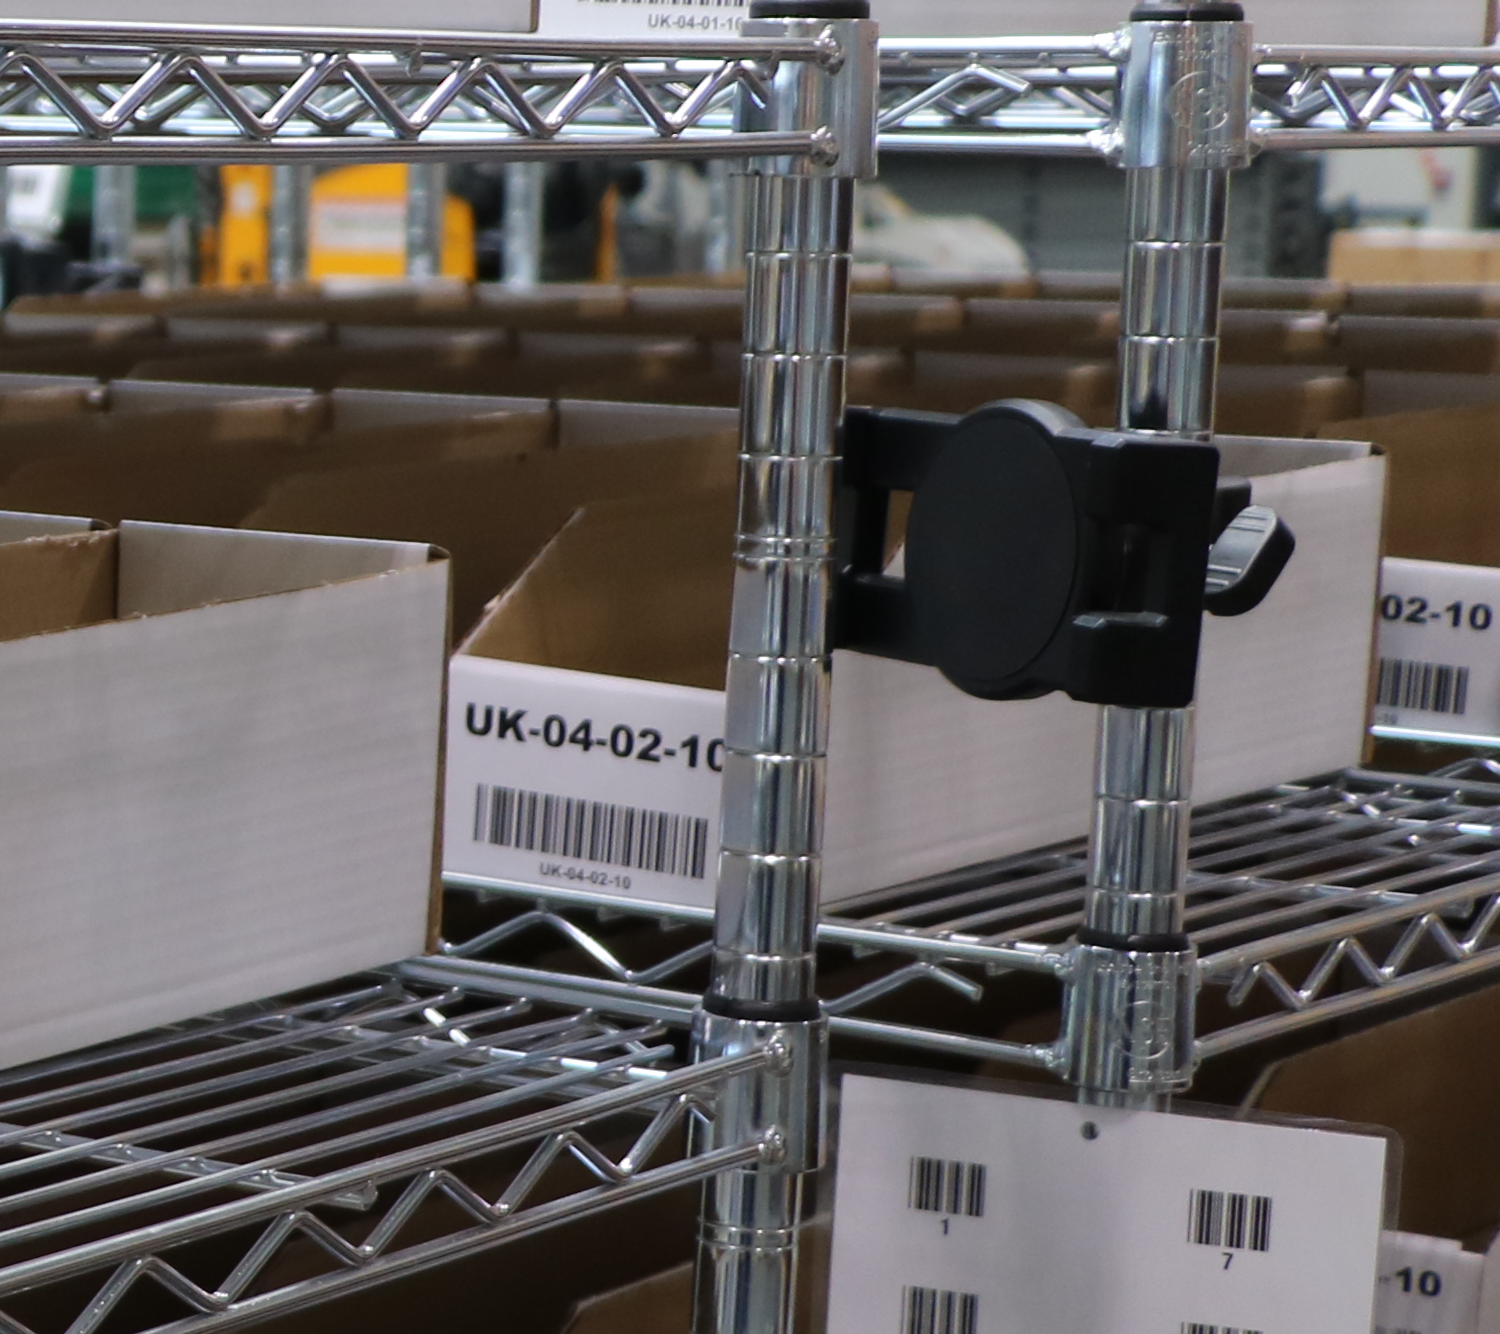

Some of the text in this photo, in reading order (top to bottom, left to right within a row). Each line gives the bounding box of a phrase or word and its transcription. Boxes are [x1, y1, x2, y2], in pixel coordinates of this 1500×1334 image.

[539, 862, 632, 890] UK-04-02-10
[940, 1218, 950, 1236] 1
[1222, 1251, 1234, 1271] 7
